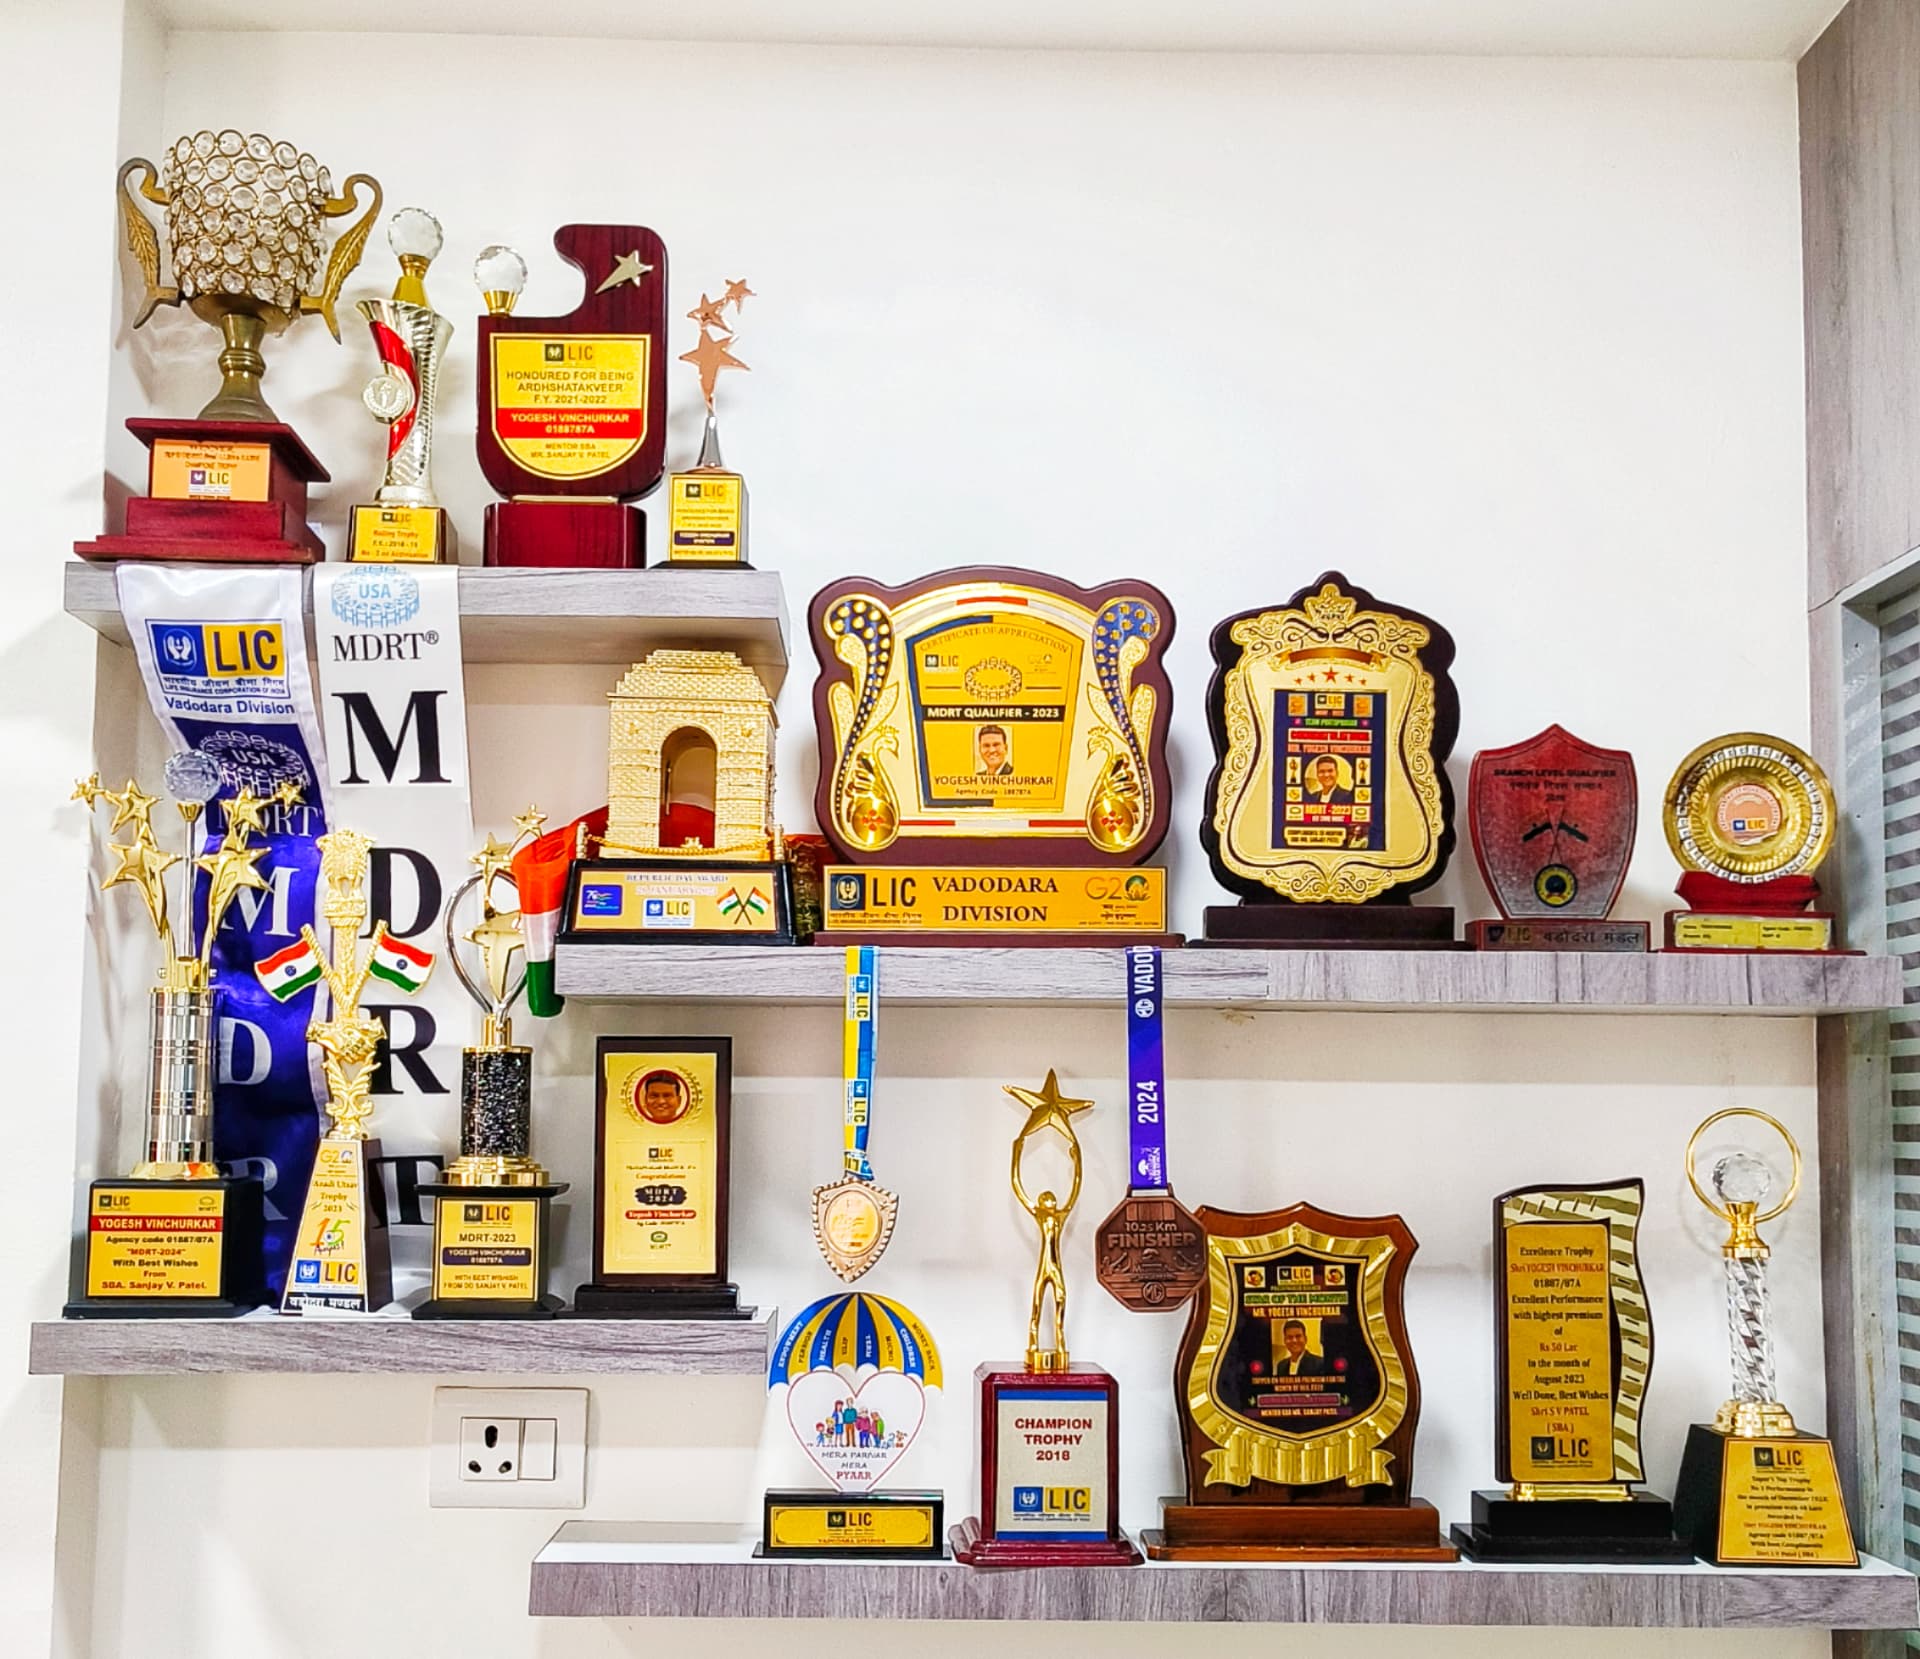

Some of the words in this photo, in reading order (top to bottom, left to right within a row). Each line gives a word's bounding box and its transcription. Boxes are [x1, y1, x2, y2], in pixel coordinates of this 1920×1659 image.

[568, 345, 593, 360] LIC
[507, 371, 570, 380] HONOURED
[574, 371, 596, 380] FOR
[600, 372, 634, 381] BEING
[555, 395, 607, 403] 2021-2022
[510, 413, 556, 422] YOGESH
[559, 413, 629, 422] VINCHURKAR
[209, 472, 229, 484] LIC
[704, 485, 724, 497] LIC
[359, 584, 391, 599] USA
[920, 629, 978, 651] CERTIFICATE
[983, 626, 997, 634] OF
[999, 626, 1068, 653] APPRECIATION
[213, 630, 277, 672] LIC
[941, 656, 959, 667] LIC
[165, 696, 232, 713] Vadodara
[237, 701, 295, 714] Division
[928, 708, 962, 717] MDRT
[964, 708, 1022, 719] QUALIFIER
[1032, 708, 1059, 717] 2023
[331, 690, 452, 784] M
[231, 749, 276, 766] USA
[935, 776, 977, 785] YOGESH
[981, 776, 1053, 785] VINCHURKAR
[1748, 820, 1765, 829] LIC
[931, 877, 1058, 893] VADODARA
[360, 847, 442, 939] D
[872, 877, 917, 907] LIC
[667, 902, 689, 915] LIC
[943, 905, 1048, 922] DIVISION
[1507, 927, 1531, 941] LIC
[856, 996, 868, 1018] LIC
[360, 1004, 451, 1095] R
[1137, 1080, 1158, 1124] 2024
[854, 1101, 866, 1123] LIC
[660, 1149, 672, 1157] LIC
[113, 1196, 130, 1206] LIC
[485, 1206, 511, 1221] LIC
[99, 1219, 142, 1229] YOGESH
[145, 1219, 216, 1229] VINCHURKAR
[1156, 1222, 1177, 1231] Km
[310, 1218, 351, 1246] 15
[459, 1233, 516, 1242] MDRT-2023
[106, 1236, 139, 1244] Agency
[1108, 1233, 1196, 1248] FINISHER
[1564, 1247, 1594, 1257] Trophy
[325, 1263, 356, 1283] LIC
[1293, 1268, 1311, 1278] LIC
[129, 1282, 163, 1290] Sanjay
[1551, 1295, 1603, 1304] Performance
[1513, 1311, 1531, 1319] with
[1534, 1311, 1563, 1321] highest
[1565, 1312, 1603, 1321] premium
[912, 1322, 928, 1350] MONEY
[1554, 1326, 1563, 1335] of
[819, 1329, 832, 1361] HEALTH
[1538, 1359, 1551, 1367] the
[1553, 1359, 1580, 1367] month
[1582, 1359, 1591, 1367] of
[1534, 1375, 1562, 1386] August
[1513, 1391, 1532, 1399] Well
[1559, 1391, 1577, 1399] Best
[1580, 1391, 1609, 1399] Wishes
[1015, 1418, 1092, 1429] CHAMPION
[1024, 1434, 1082, 1445] TROPHY
[1559, 1438, 1589, 1458] LIC
[1036, 1450, 1070, 1460] 2018
[1777, 1450, 1802, 1466] LIC
[836, 1472, 872, 1480] PYAAR
[1049, 1489, 1086, 1510] LIC
[849, 1512, 872, 1527] LIC
